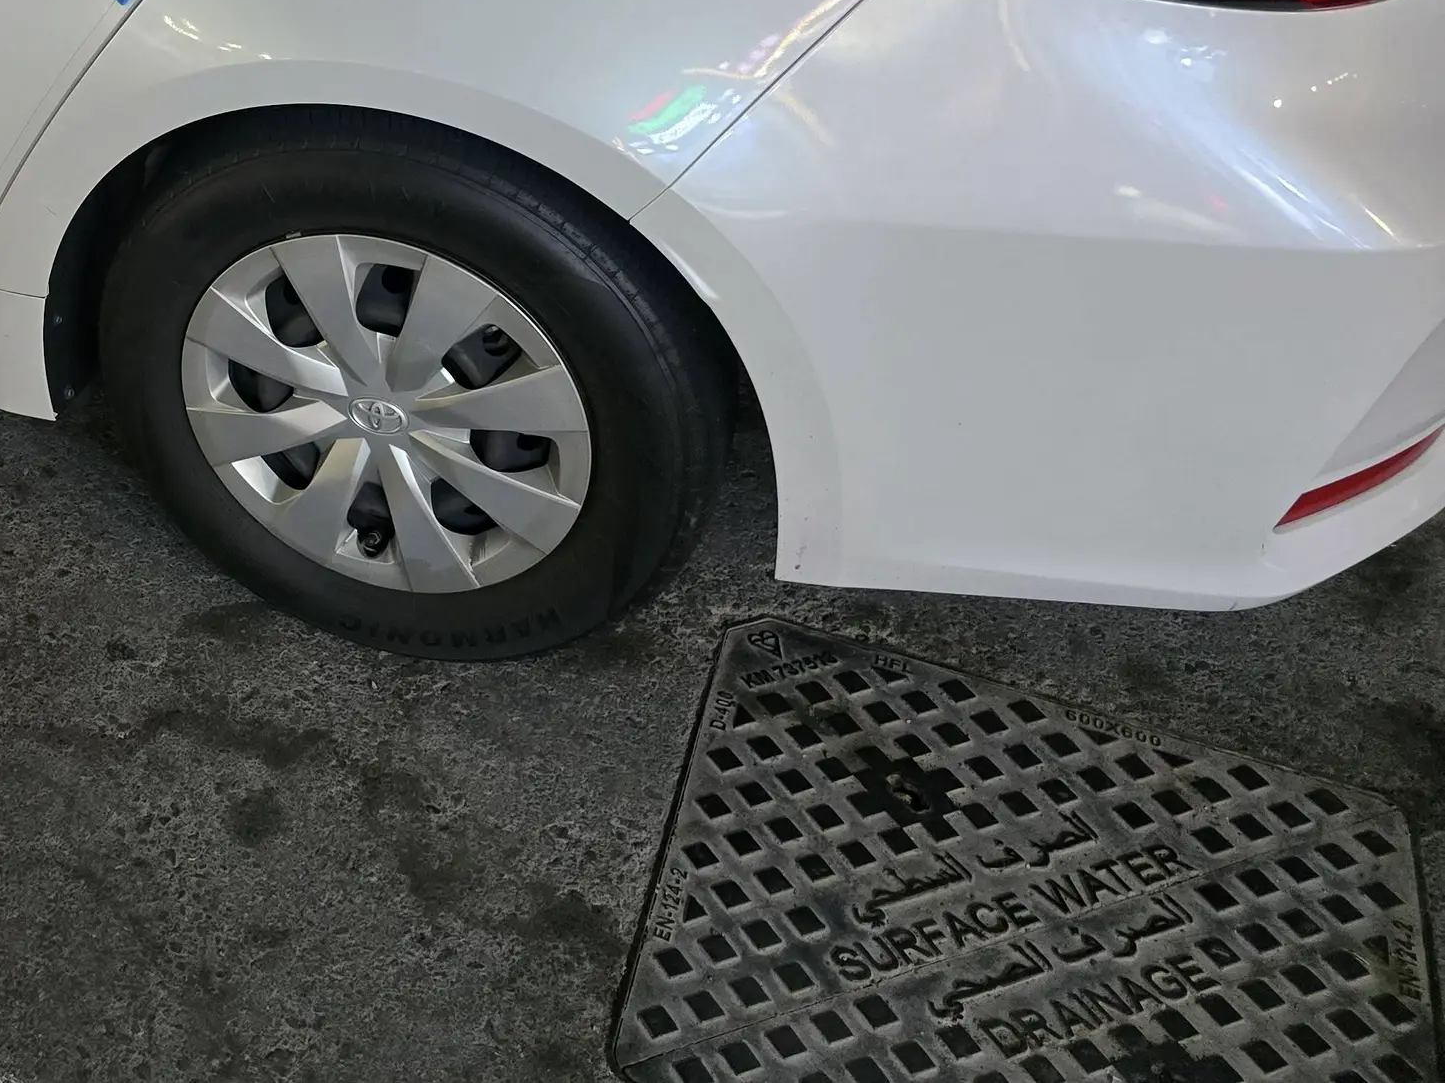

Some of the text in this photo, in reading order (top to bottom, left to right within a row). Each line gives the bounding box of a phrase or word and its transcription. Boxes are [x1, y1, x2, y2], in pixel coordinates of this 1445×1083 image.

[741, 669, 776, 689] KM
[1065, 710, 1163, 747] 600X600
[655, 868, 689, 944] EN-124-2
[852, 811, 1100, 928] الصرف السطحي
[830, 844, 1200, 982] SURFACE WATER
[1051, 891, 1195, 964] الصرف
[977, 953, 1222, 1059] DRAINAGE
